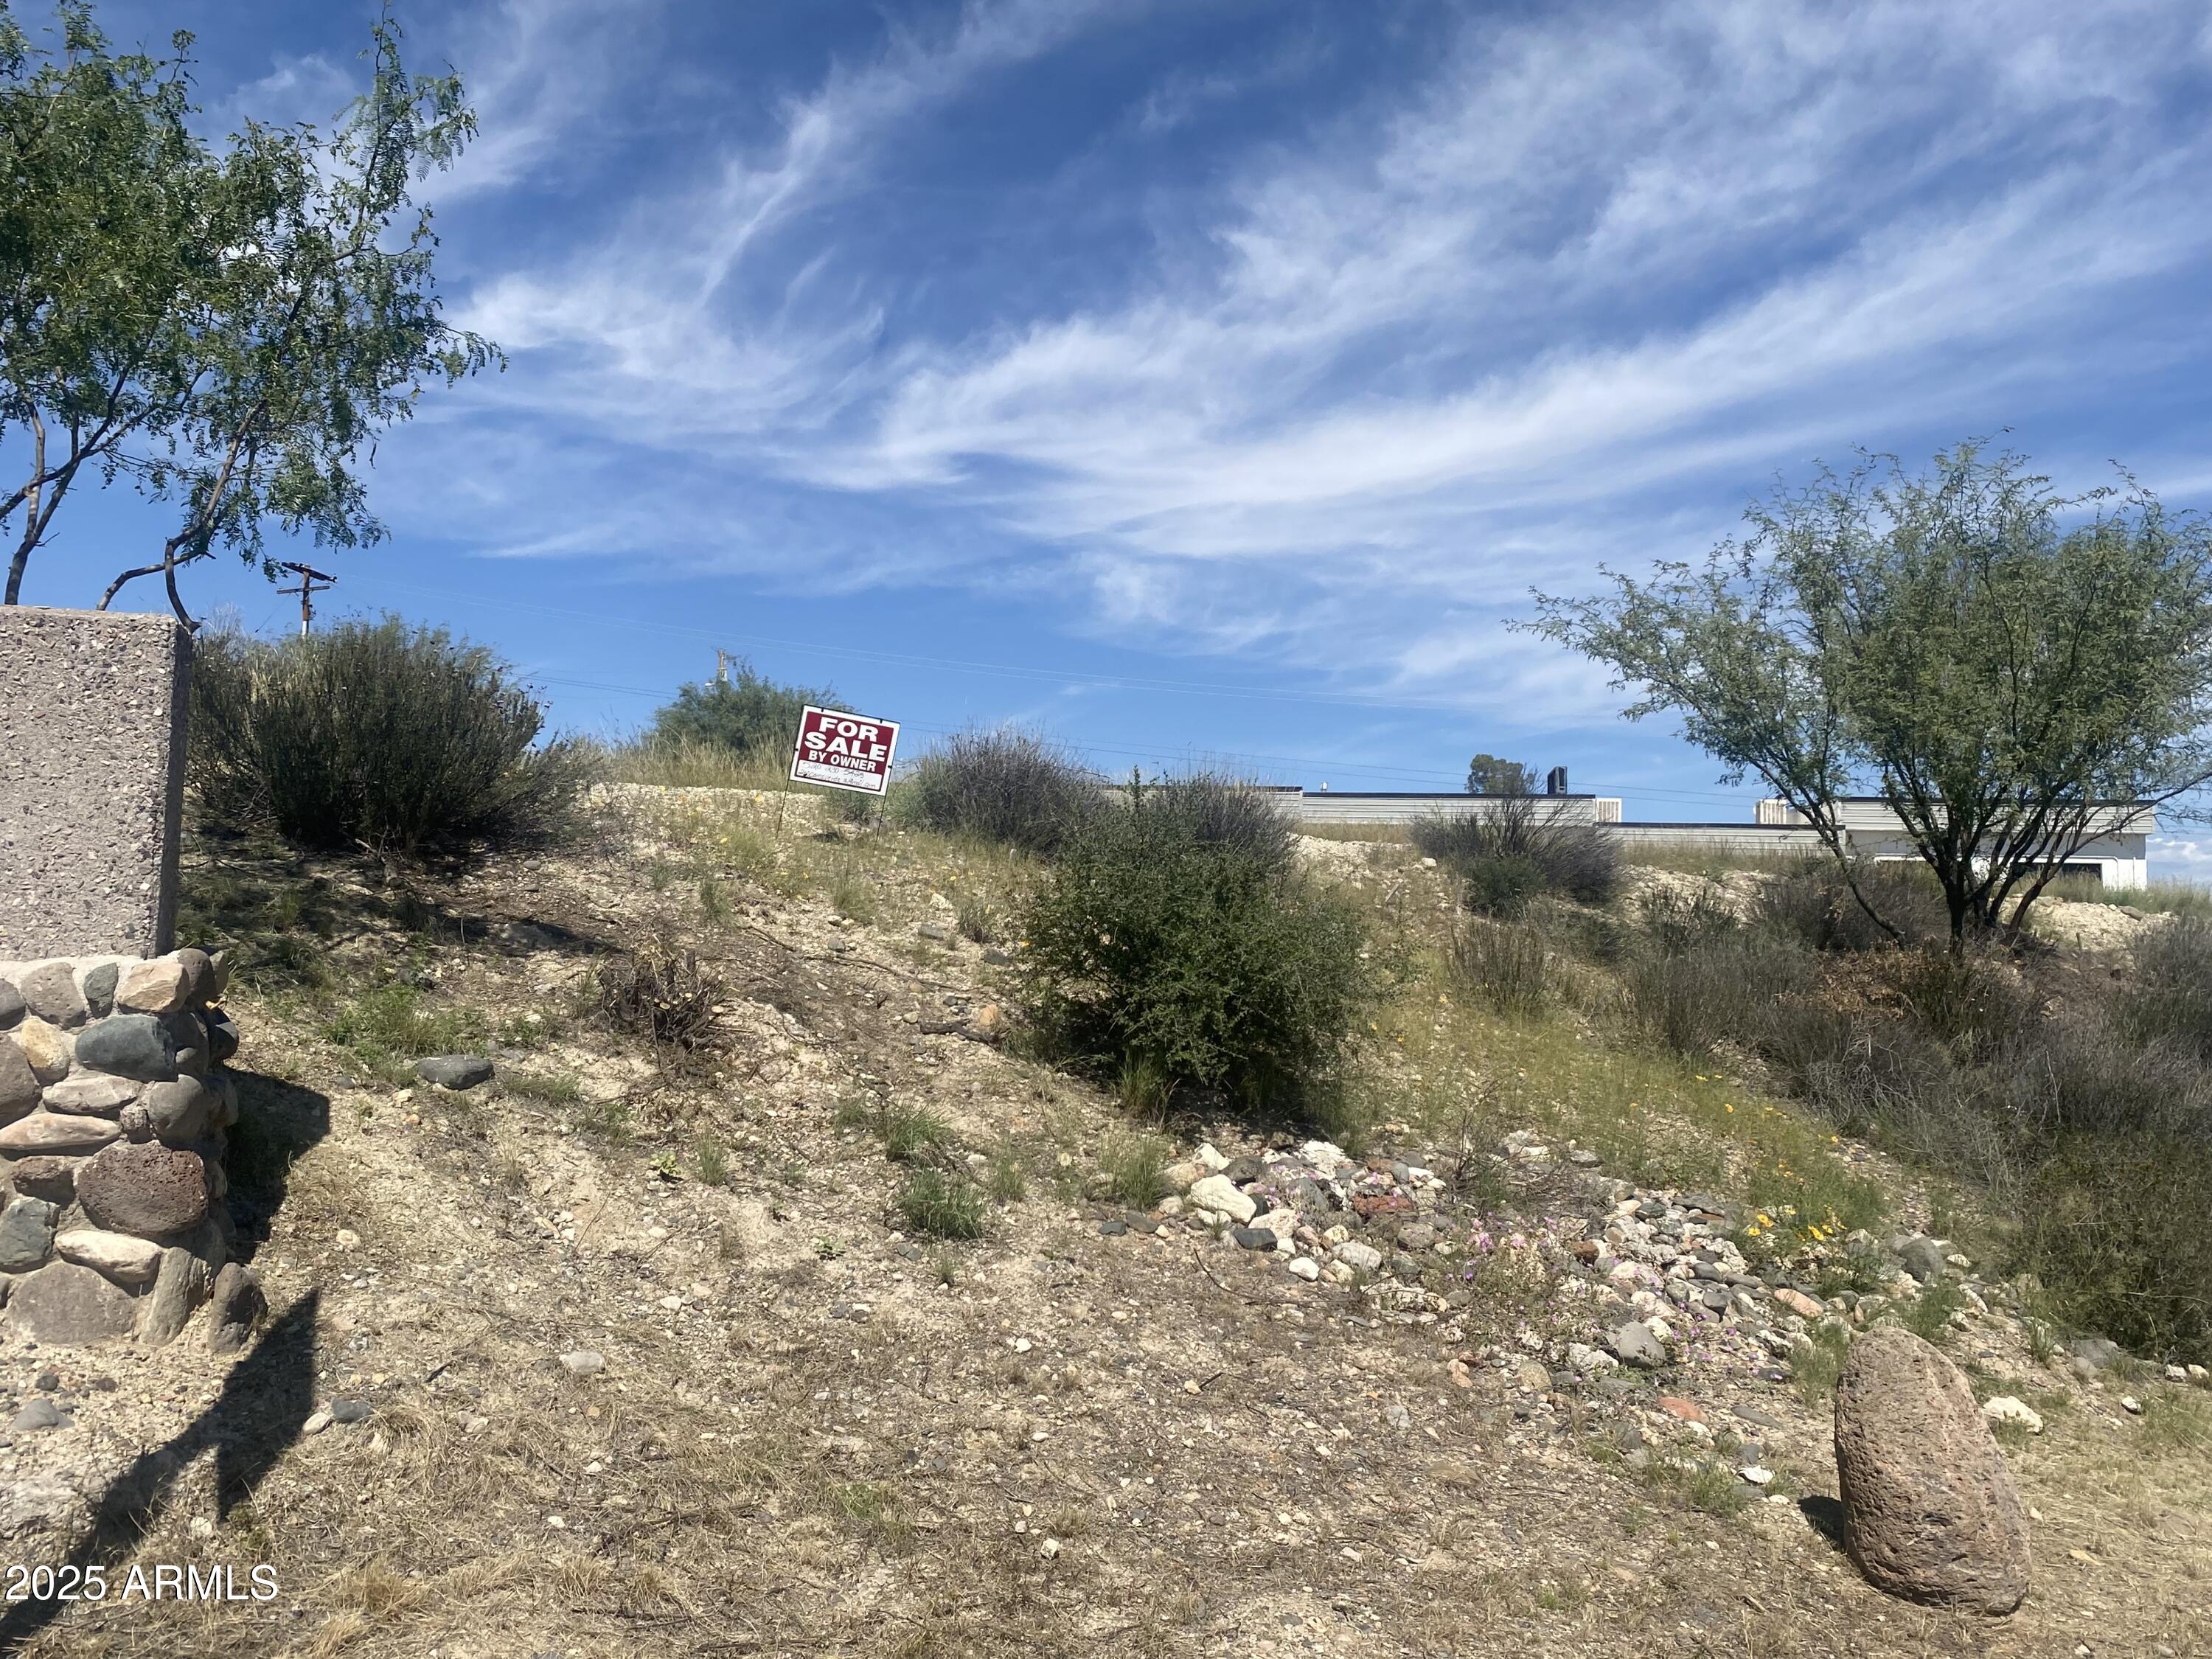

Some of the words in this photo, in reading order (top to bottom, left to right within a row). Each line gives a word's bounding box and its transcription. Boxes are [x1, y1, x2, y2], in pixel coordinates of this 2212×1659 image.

[818, 716, 879, 742] FOR
[804, 731, 888, 762] SALE
[808, 749, 827, 762] BY
[830, 754, 877, 772] OWNER
